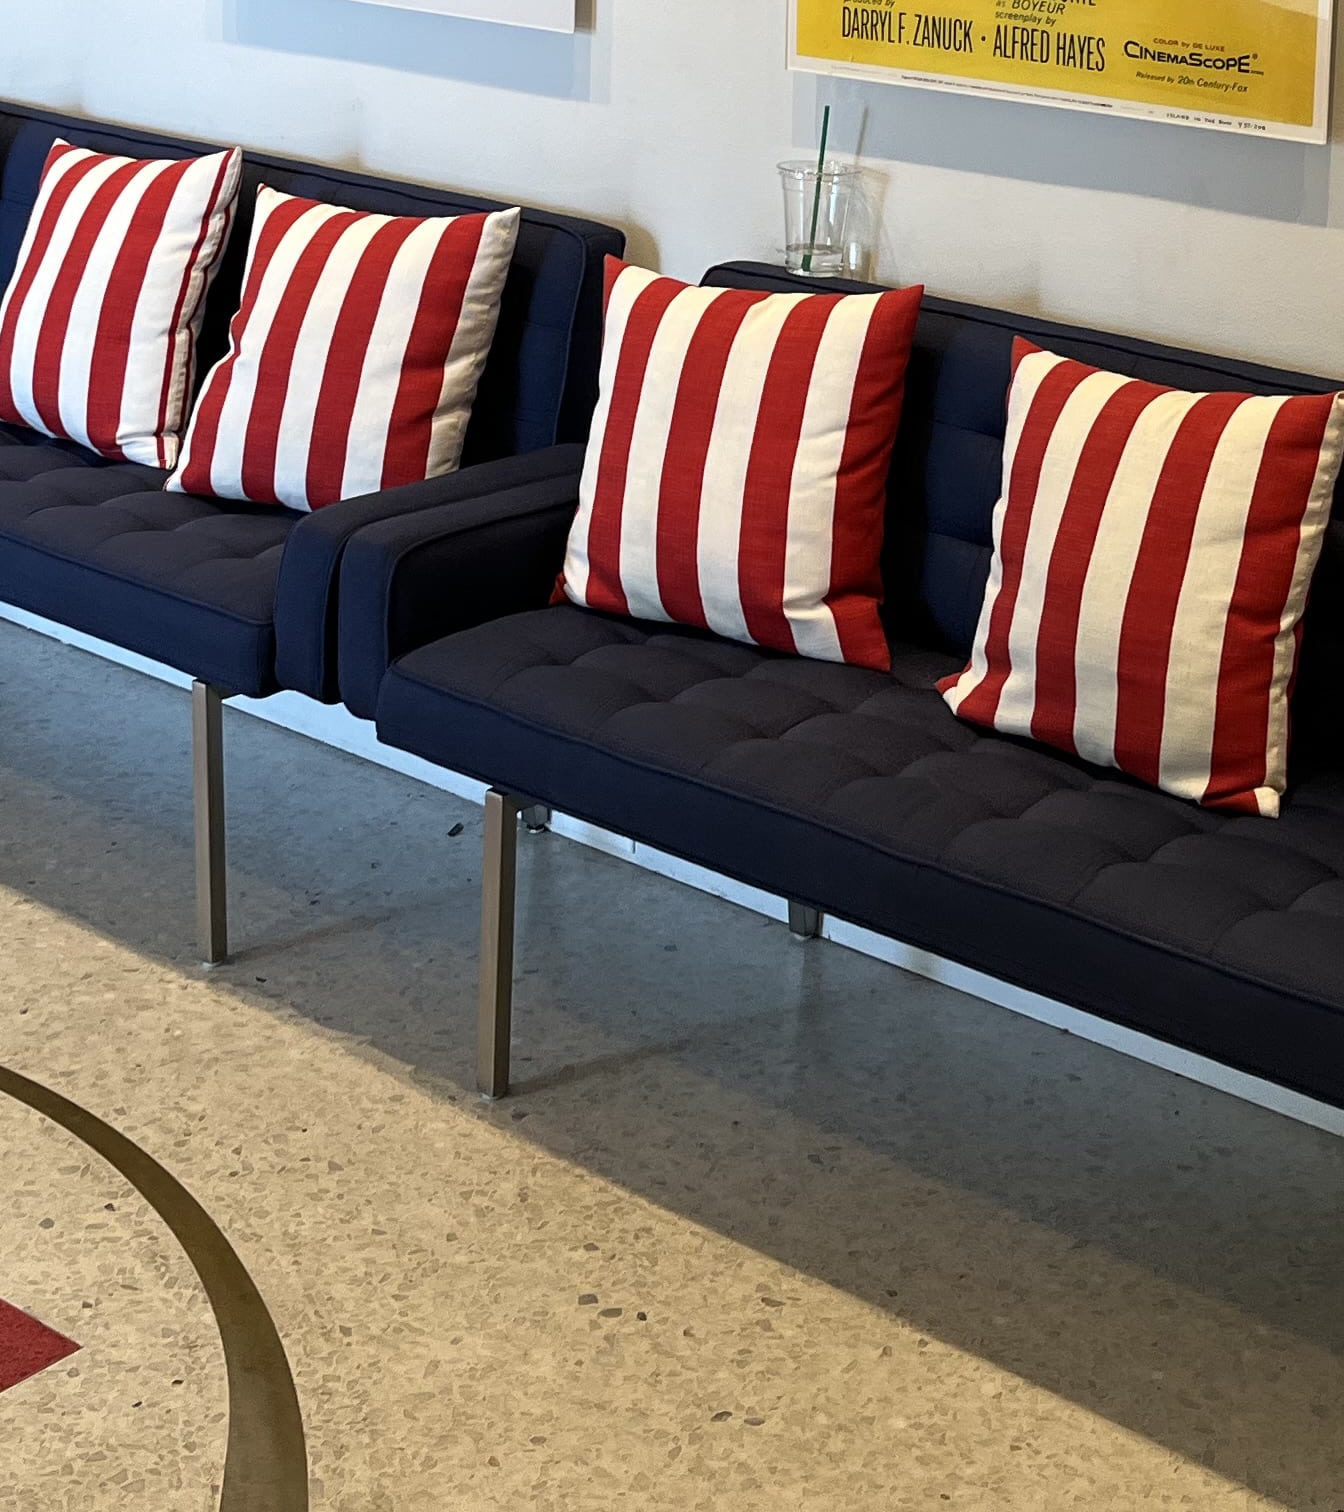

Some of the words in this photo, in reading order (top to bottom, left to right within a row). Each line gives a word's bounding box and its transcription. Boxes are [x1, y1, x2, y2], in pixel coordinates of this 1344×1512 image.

[842, 6, 895, 43] DARRYL
[898, 12, 910, 45] F.
[913, 14, 973, 53] ZANUCK
[995, 11, 1042, 26] screenplay
[993, 24, 1050, 64] ALFRED
[1056, 32, 1105, 73] HAYES
